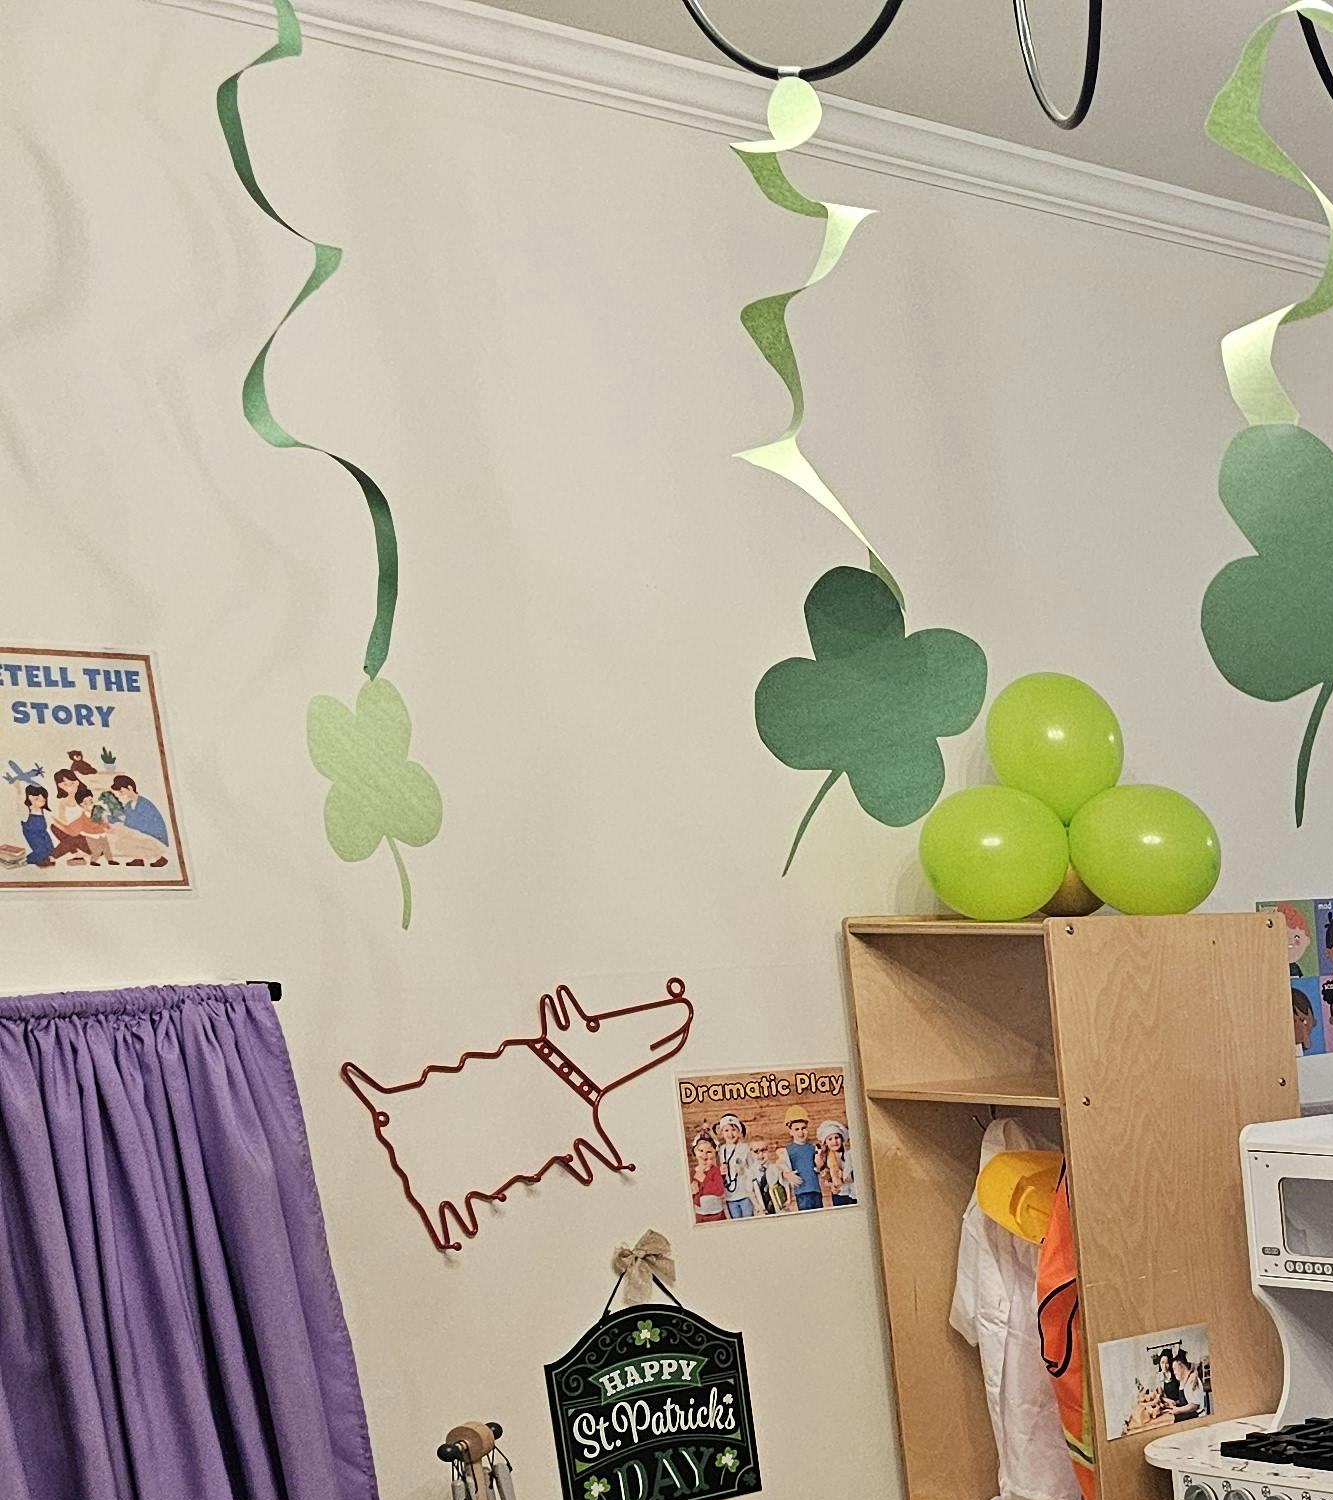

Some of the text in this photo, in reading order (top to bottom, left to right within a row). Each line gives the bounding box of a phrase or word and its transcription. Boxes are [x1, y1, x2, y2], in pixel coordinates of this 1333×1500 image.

[0, 664, 141, 692] TELL THE
[11, 701, 116, 728] STORY
[679, 1072, 844, 1104] Dramatic Play
[599, 1359, 698, 1397] HAPPY
[573, 1412, 622, 1459] St.
